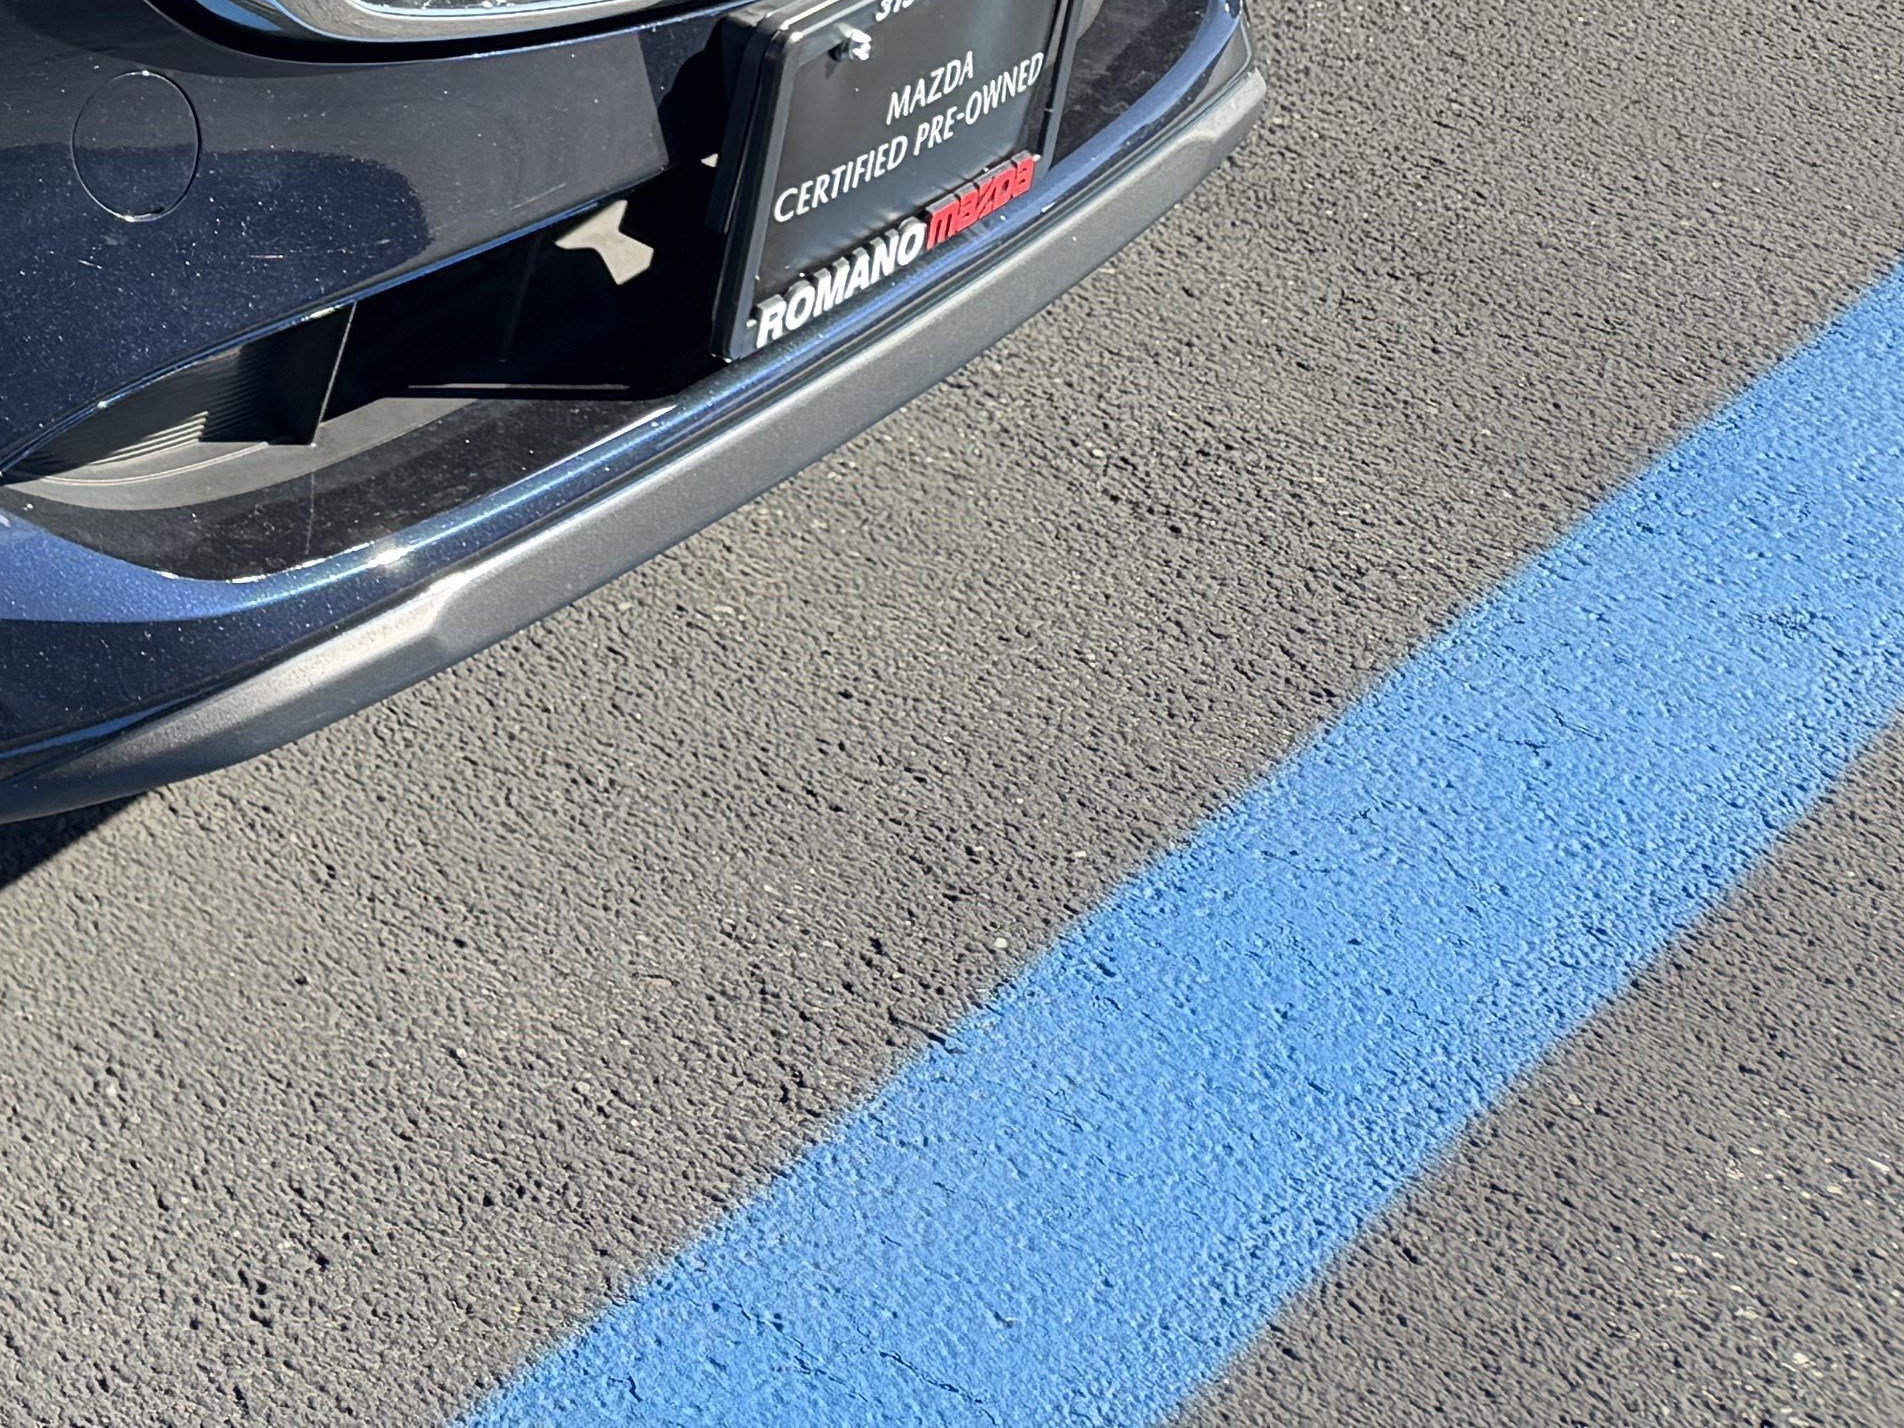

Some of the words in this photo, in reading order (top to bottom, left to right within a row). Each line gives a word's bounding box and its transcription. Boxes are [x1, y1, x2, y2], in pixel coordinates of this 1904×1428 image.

[774, 135, 908, 223] CERTIFIED
[914, 52, 1045, 156] PRE-OWNED
[886, 50, 974, 125] MAZDA
[756, 216, 927, 349] ROMANO
